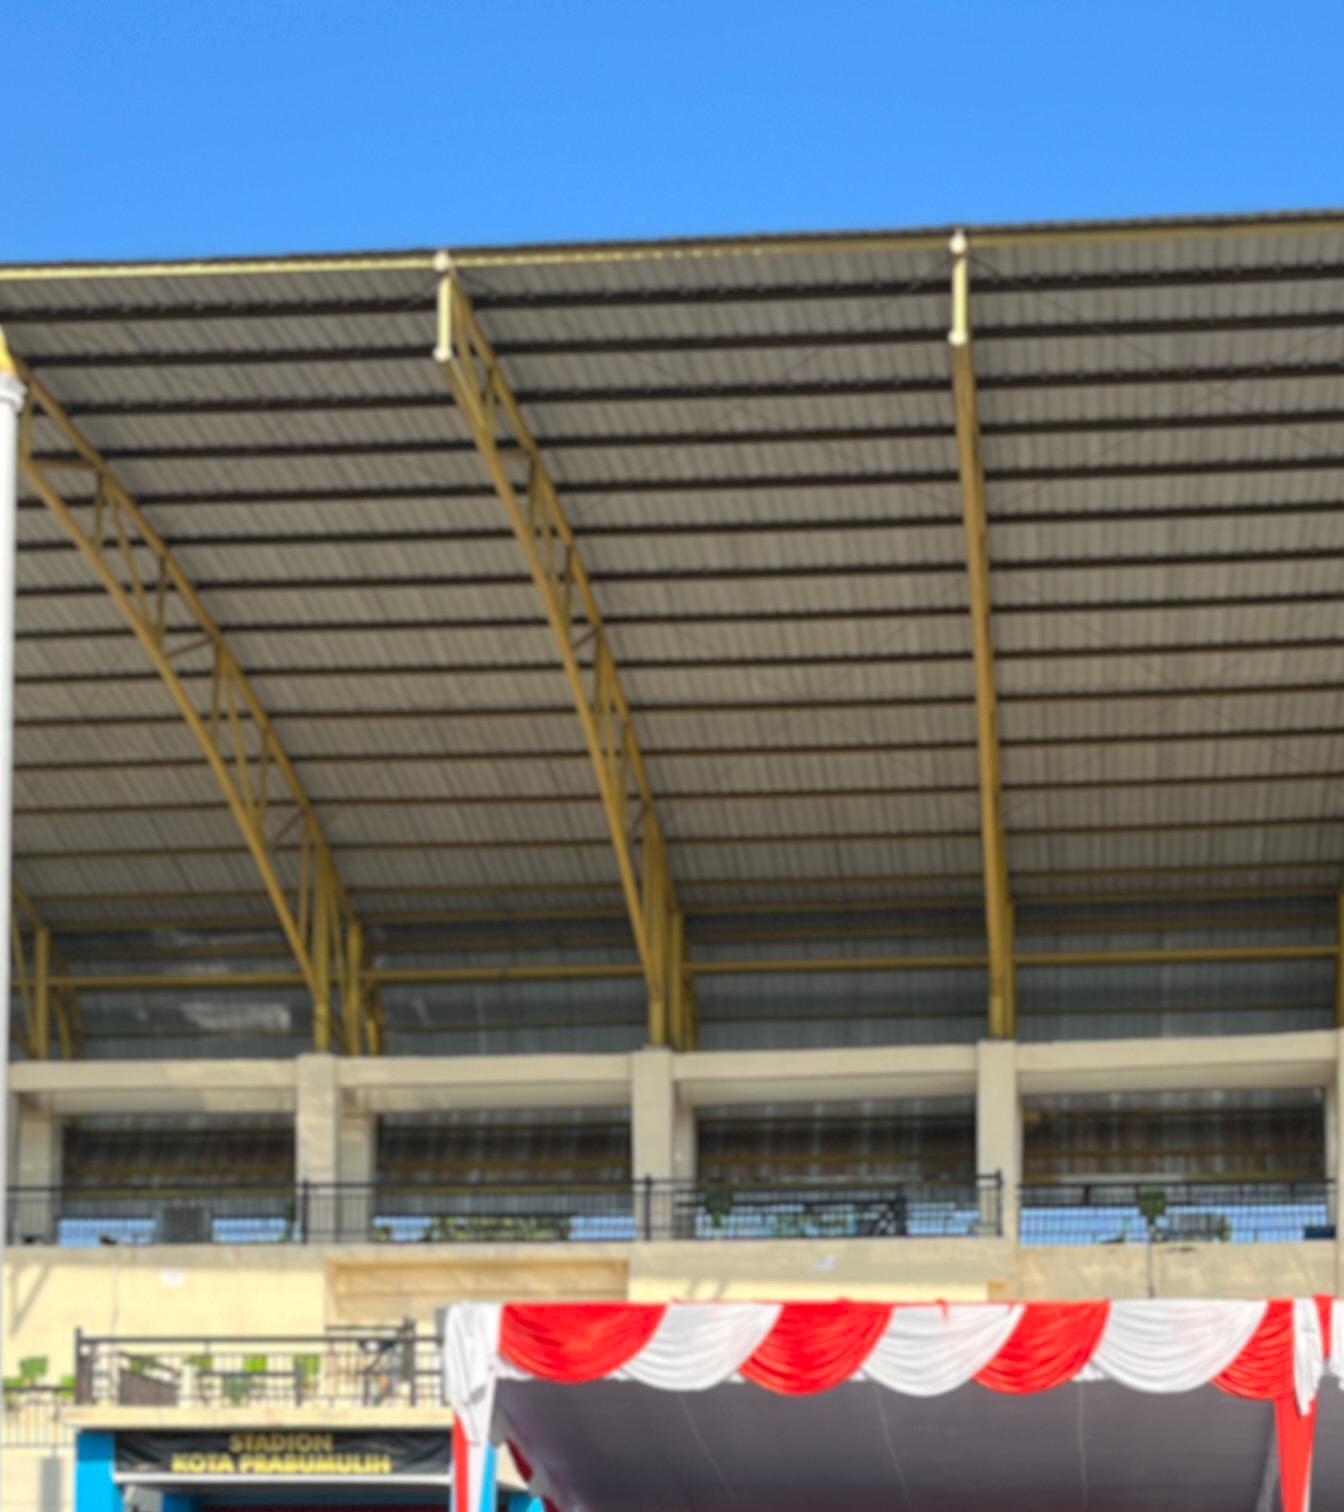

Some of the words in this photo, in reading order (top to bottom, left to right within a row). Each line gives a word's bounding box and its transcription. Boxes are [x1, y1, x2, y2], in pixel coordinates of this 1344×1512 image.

[229, 1433, 334, 1453] STADION
[171, 1453, 234, 1473] KOTA
[239, 1453, 392, 1473] PRABUMULIH
